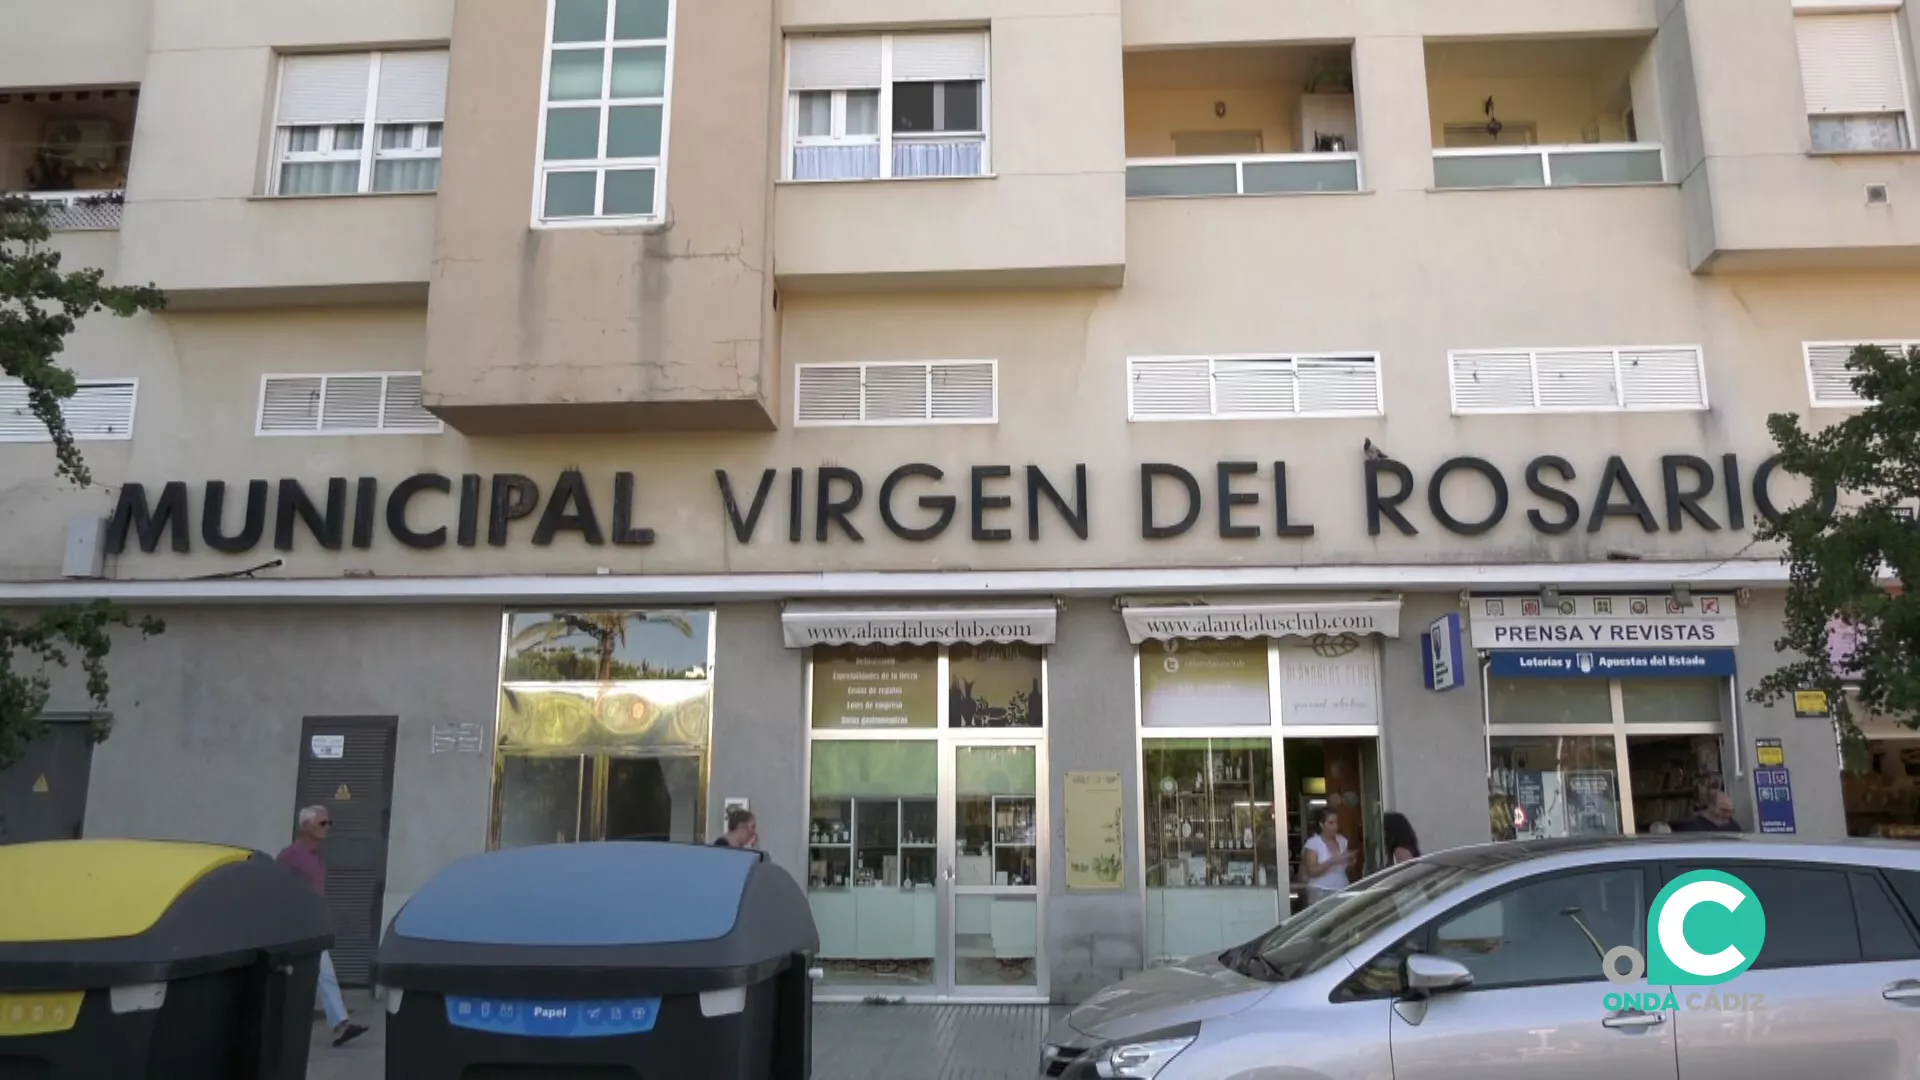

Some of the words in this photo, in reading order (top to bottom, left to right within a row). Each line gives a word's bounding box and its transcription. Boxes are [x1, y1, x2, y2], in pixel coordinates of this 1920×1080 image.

[105, 470, 655, 553] MUNICIPAL
[715, 463, 1088, 543] VIRGEN
[1141, 461, 1314, 539] DEL
[807, 621, 1032, 640] www.alandalusclub.com
[1147, 612, 1374, 634] www.alandalusclub.com
[1495, 625, 1583, 642] PRENSA
[1590, 625, 1602, 640] Y
[1610, 624, 1715, 641] REVISTAS
[1565, 659, 1572, 670] y
[1599, 656, 1648, 669] Apuestas
[1650, 655, 1667, 667] del
[1669, 656, 1706, 667] Estado
[534, 1006, 567, 1019] Papel
